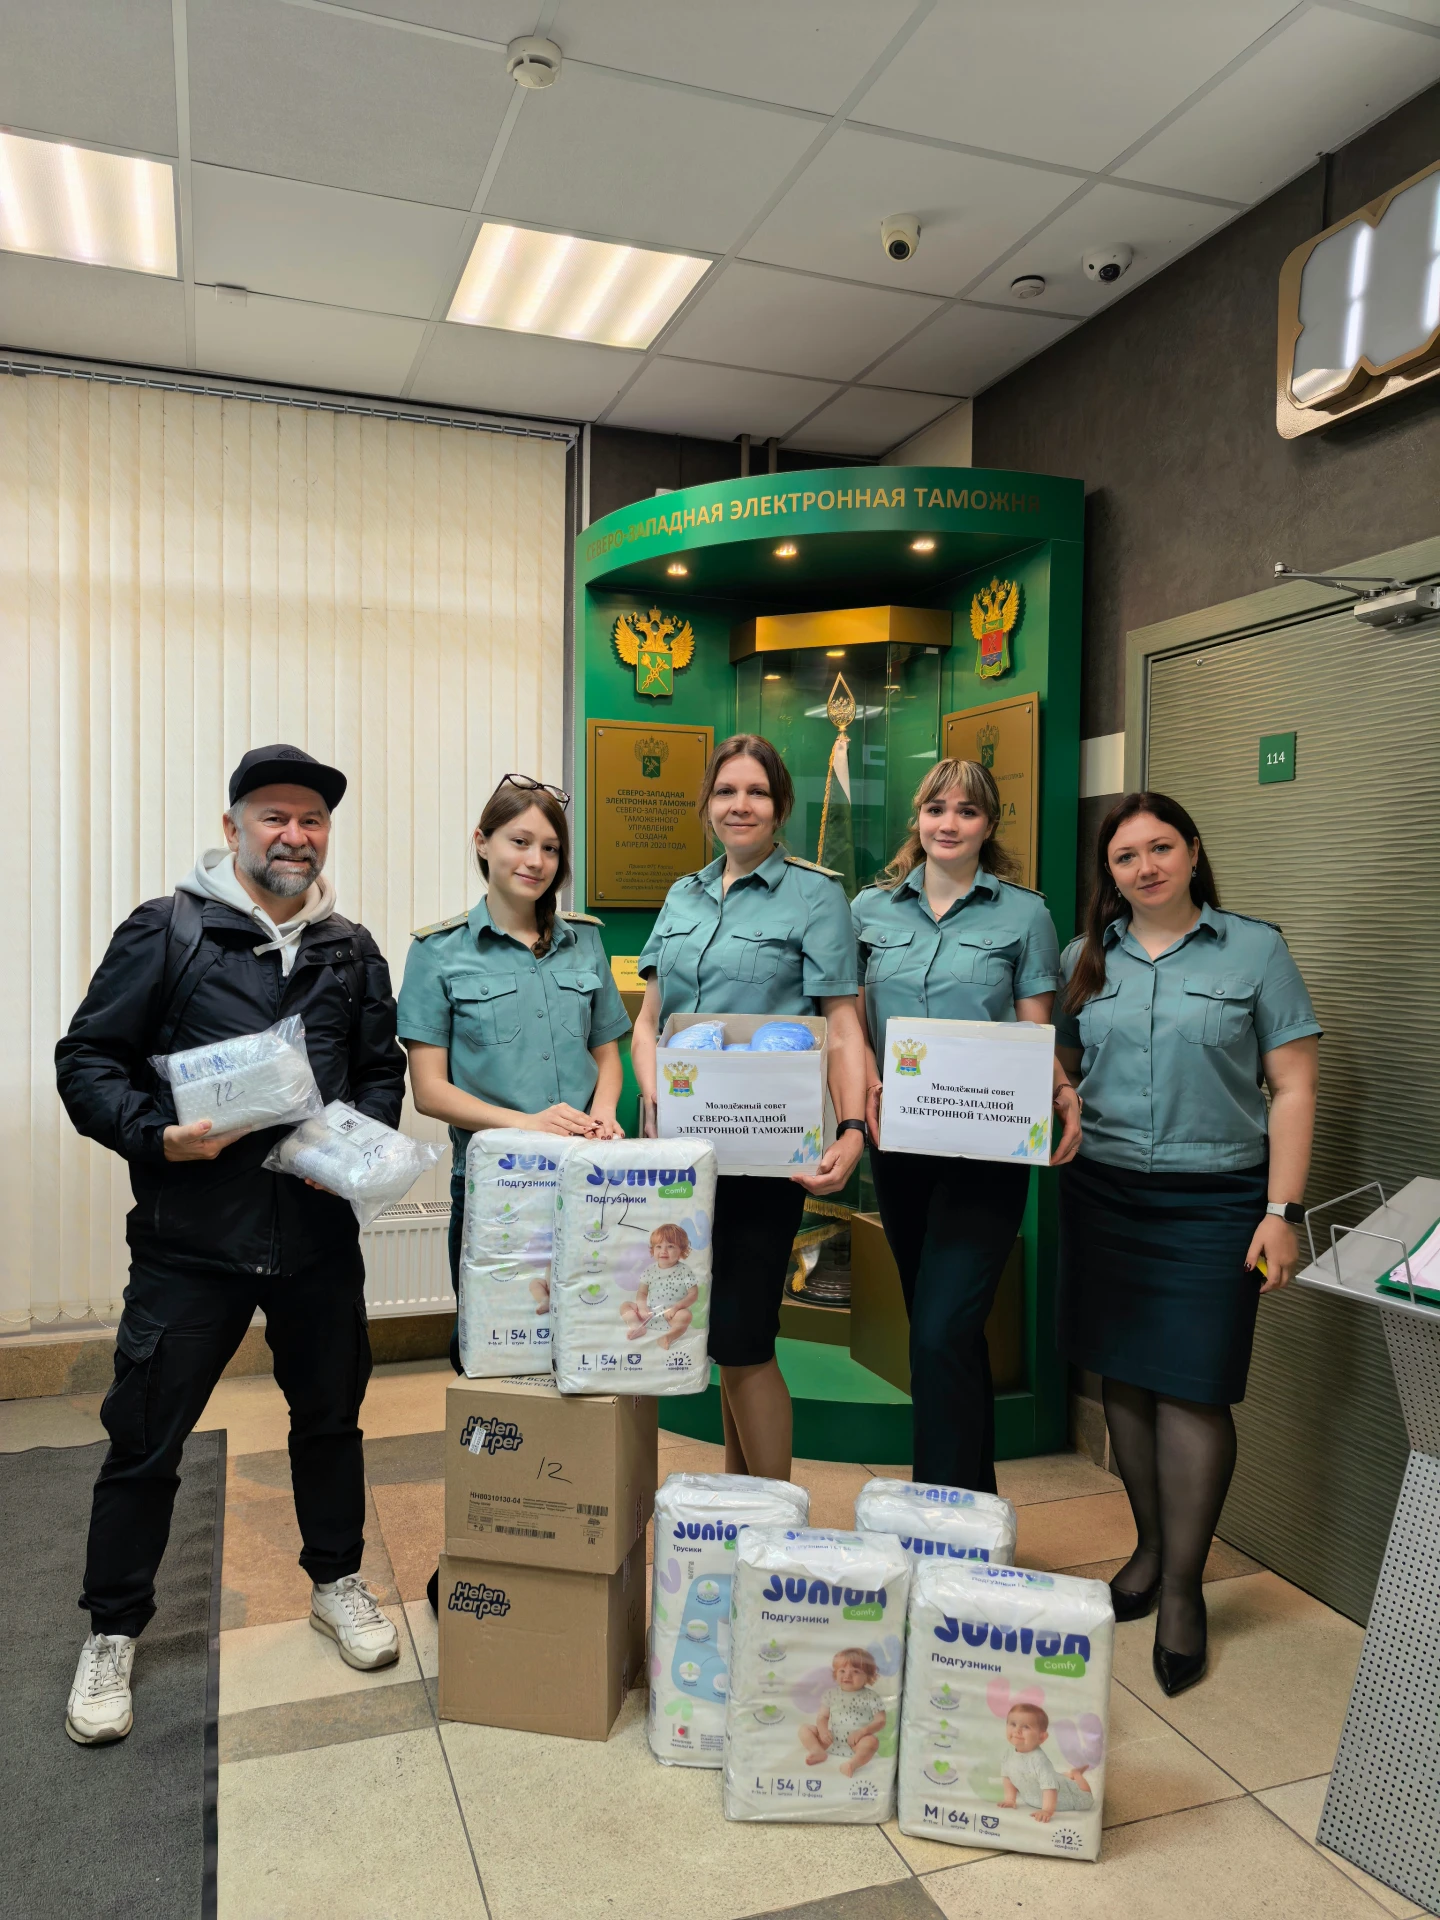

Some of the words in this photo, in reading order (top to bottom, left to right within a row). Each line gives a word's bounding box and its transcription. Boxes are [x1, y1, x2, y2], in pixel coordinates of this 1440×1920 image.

[586, 502, 723, 562] СЕВЕРО-ЗАПАДНАЯ
[730, 488, 905, 520] ЭЛЕКТРОННАЯ
[913, 488, 1040, 514] ТАМОЖНЯ
[1266, 751, 1285, 765] 114
[617, 789, 685, 799] СЕВЕРО-ЗАПАДНАЯ
[606, 797, 657, 806] ЭЛЕКТРОННАЯ
[659, 800, 696, 808] ТАМОЖНЯ
[616, 806, 687, 816] СЕВЕРО-ЗАПАДНОГО
[624, 815, 679, 824] ТАМОЖЕННОГО
[628, 824, 674, 832] УПРАВЛЕНИЯ
[634, 832, 668, 841] СОЗДАНА
[621, 841, 649, 849] АПРЕЛЯ
[668, 842, 687, 850] ГОДА
[931, 1082, 989, 1095] Молодёжный
[991, 1088, 1015, 1097] совет
[705, 1101, 762, 1110] Молодёжный
[763, 1102, 786, 1110] совет
[917, 1095, 1014, 1111] СЕВЕРО-ЗАПАДНОЙ
[692, 1113, 786, 1123] СЕВЕРО-ЗАПАДНОЙ
[900, 1105, 974, 1120] ЭЛЕКТРОННОЙ
[977, 1112, 1031, 1125] ТАМОЖНИ
[676, 1126, 749, 1134] ЭЛЕКТРОННОЙ
[751, 1126, 804, 1134] ТАМОЖНИ
[497, 1179, 557, 1189] Подгузники
[664, 1186, 688, 1196] Comfy
[586, 1194, 647, 1205] Подгузники
[493, 1329, 499, 1340] L
[511, 1329, 527, 1340] 54
[582, 1354, 589, 1365] L
[601, 1354, 617, 1365] 54
[674, 1357, 684, 1366] 12
[467, 1416, 518, 1437] Helen
[460, 1428, 523, 1455] Hrper
[537, 1457, 572, 1484] 12
[673, 1520, 750, 1541] Junio
[673, 1544, 702, 1553] Трусики
[455, 1581, 505, 1602] Helen
[448, 1593, 511, 1620] Harper
[761, 1610, 830, 1625] Подгузники
[850, 1608, 876, 1618] Comfy
[931, 1652, 1002, 1673] Подгузники
[1044, 1660, 1077, 1672] Comfy
[756, 1777, 764, 1789] L
[777, 1778, 794, 1791] 54
[858, 1787, 869, 1796] 12
[925, 1804, 938, 1819] M
[948, 1810, 969, 1825] 64
[1061, 1835, 1073, 1845] 12
